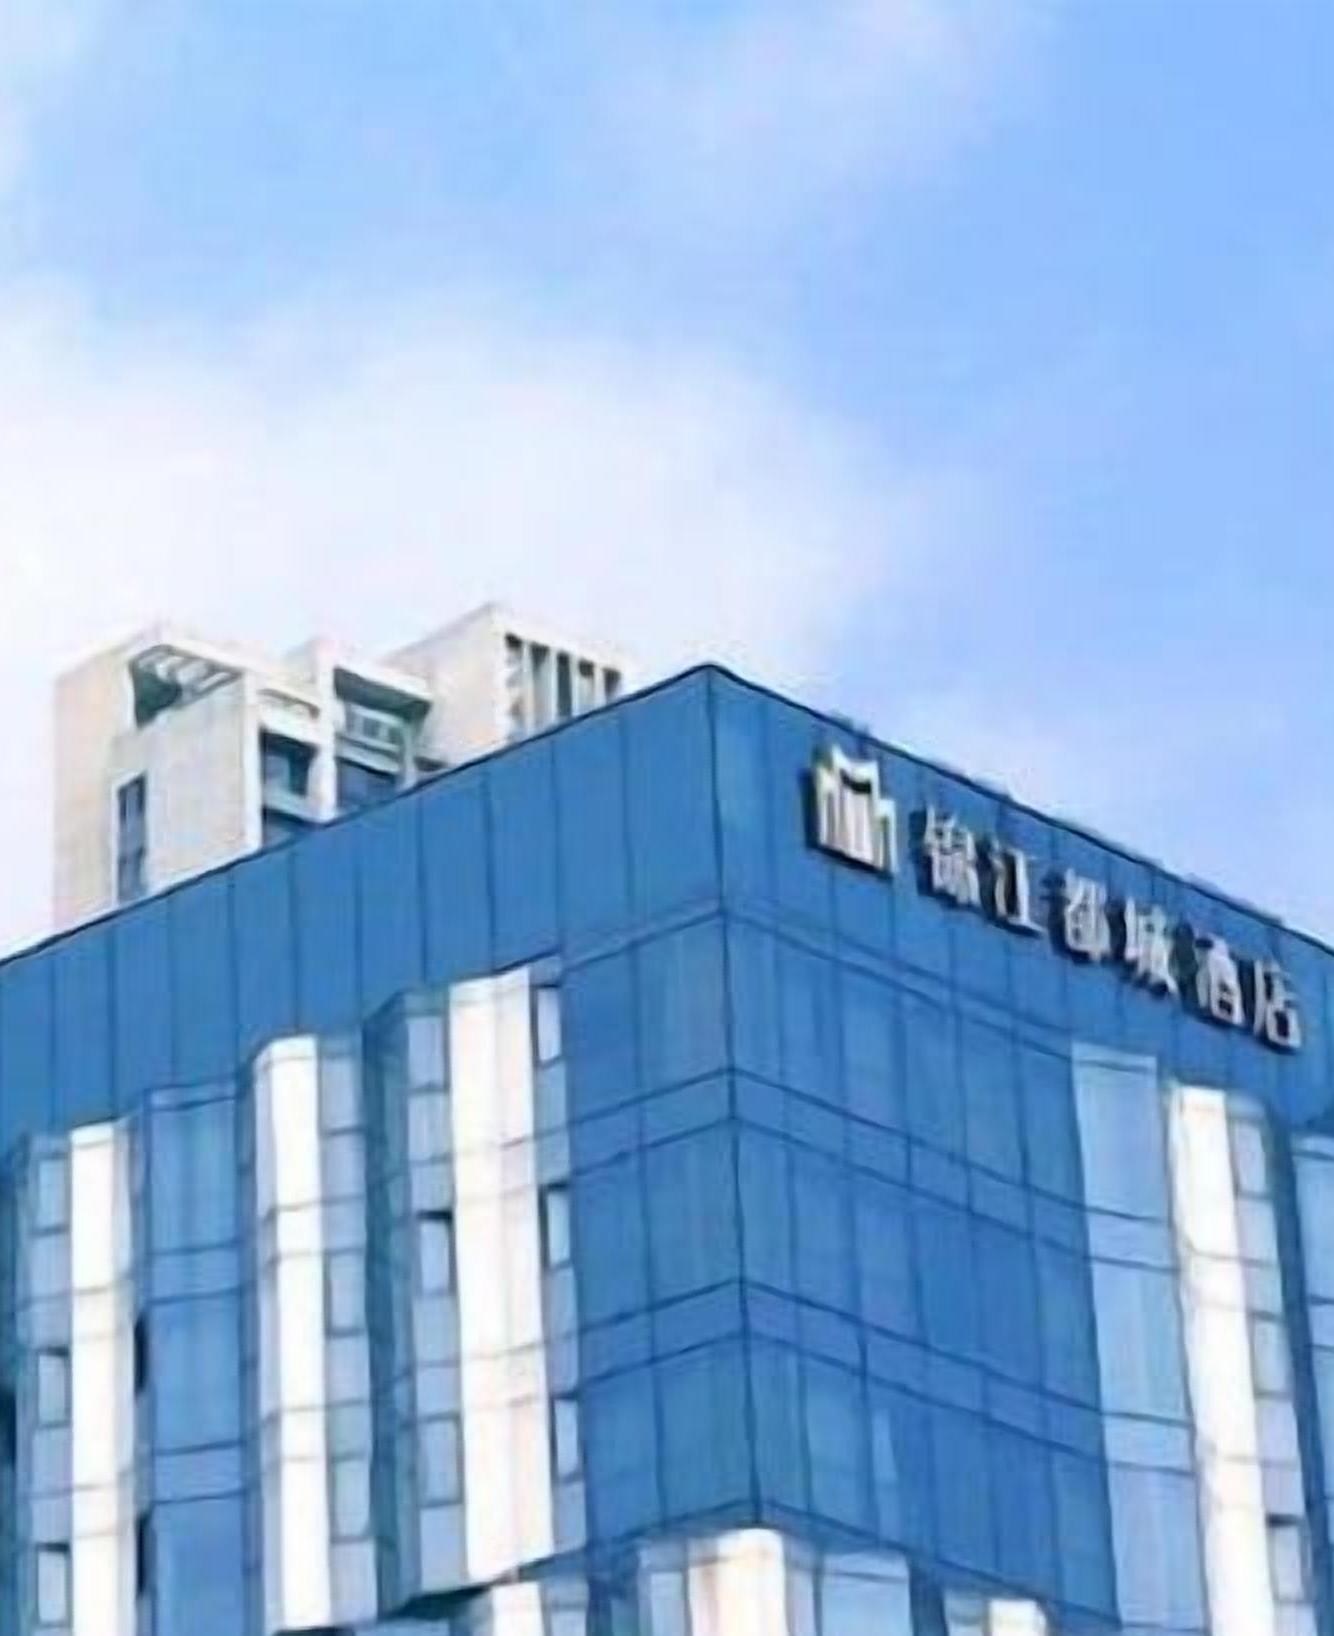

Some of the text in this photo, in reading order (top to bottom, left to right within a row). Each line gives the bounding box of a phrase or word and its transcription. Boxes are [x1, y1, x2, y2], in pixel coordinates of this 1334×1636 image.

[923, 804, 1303, 1050] 锦江都城酒店
